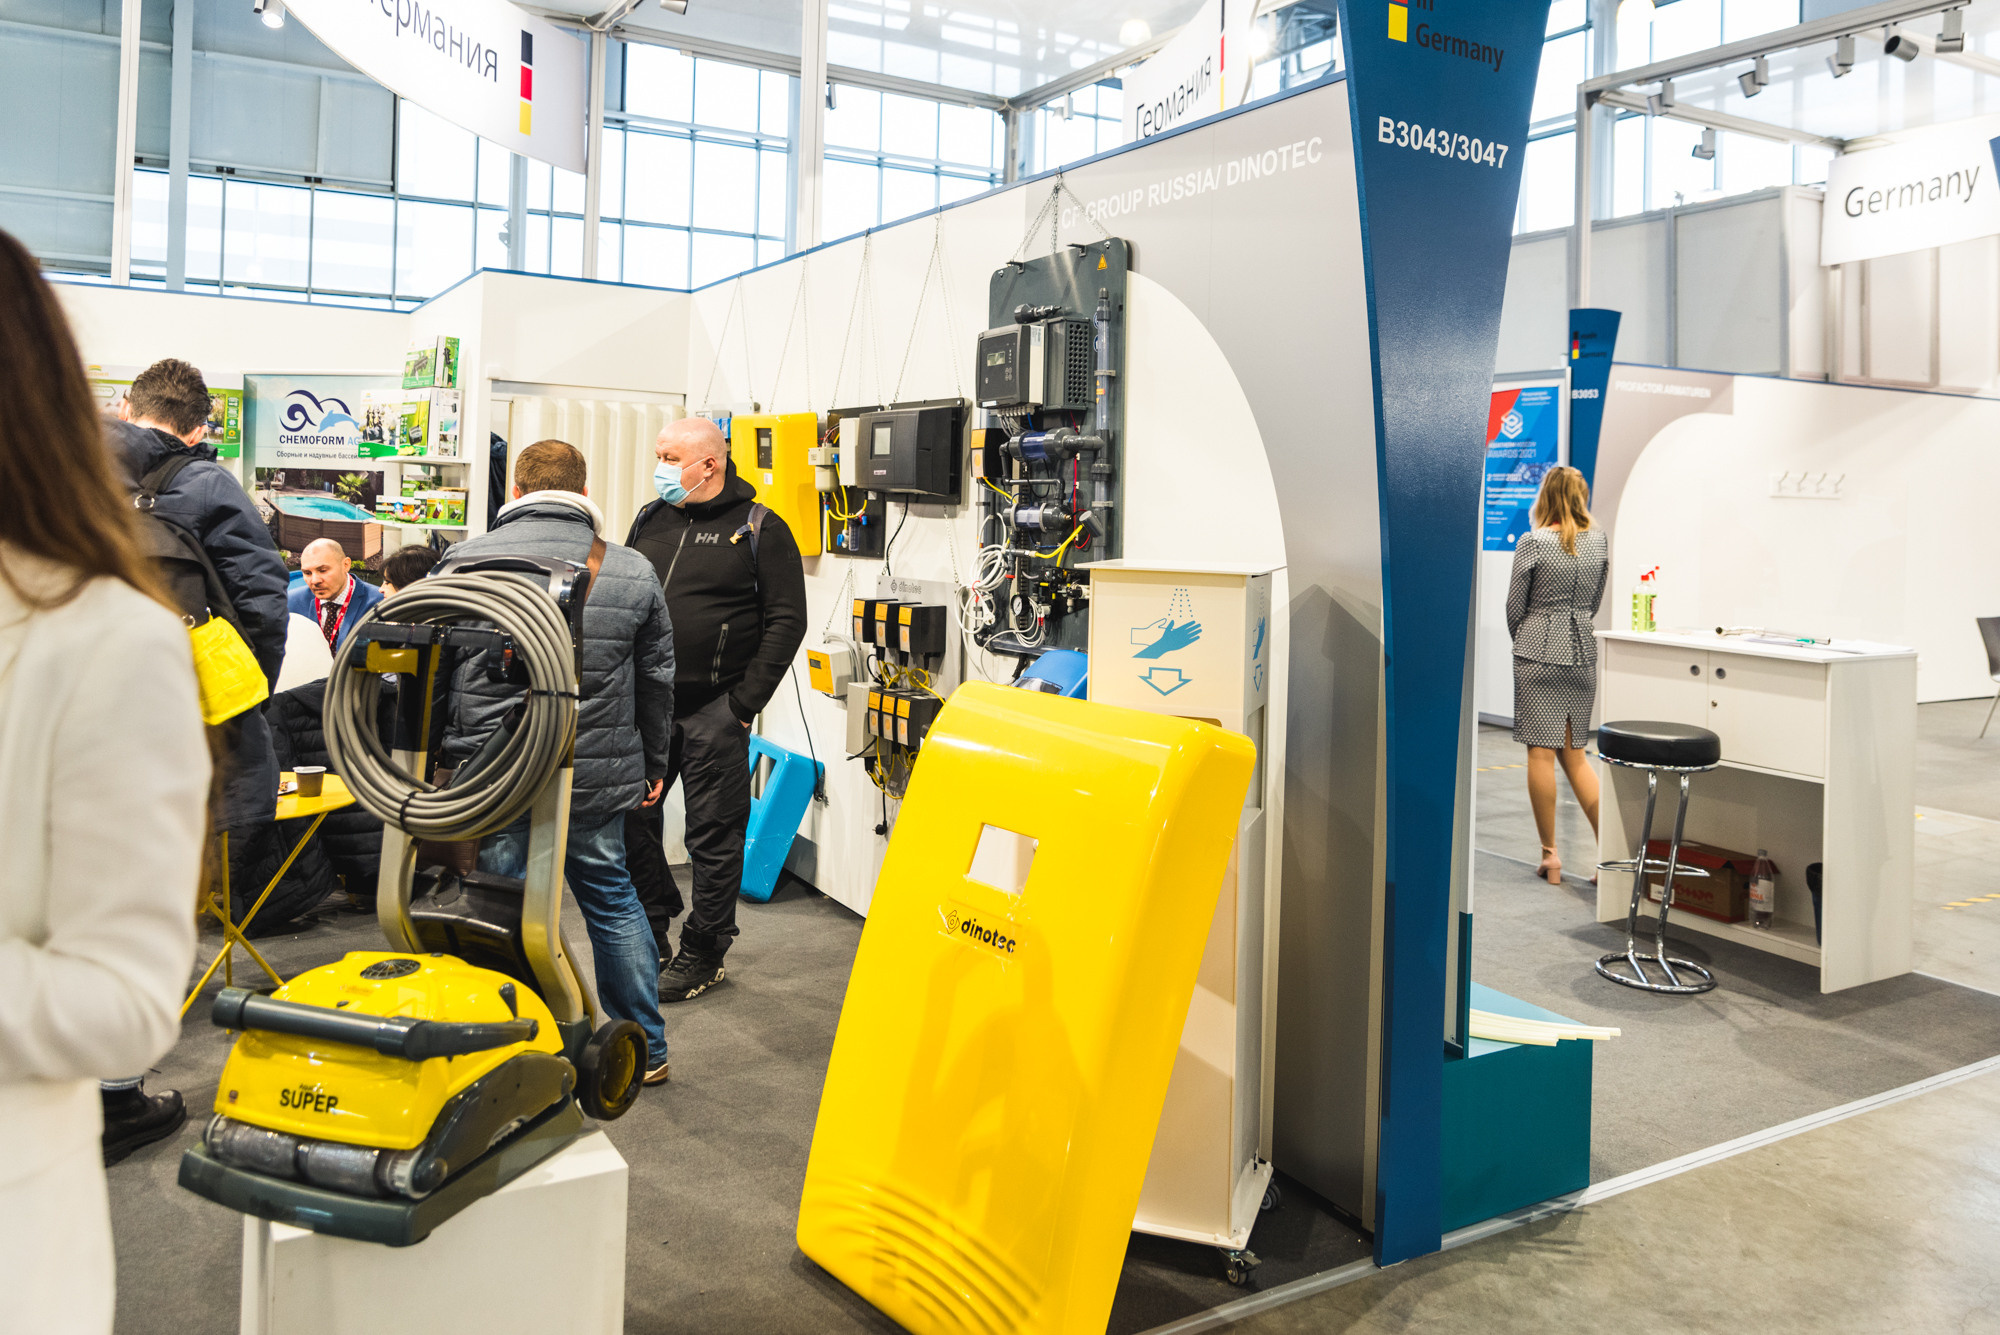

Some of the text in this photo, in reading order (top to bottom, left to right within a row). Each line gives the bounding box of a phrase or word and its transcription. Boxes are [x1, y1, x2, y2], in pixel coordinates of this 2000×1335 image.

[1415, 23, 1504, 73] Germany
[1135, 55, 1212, 141] Германия
[1378, 115, 1509, 169] B3043/3047
[1085, 188, 1144, 222] GROUP
[1148, 164, 1222, 208] RUSSIA/
[1226, 136, 1323, 186] DINOTEC
[1845, 166, 1981, 218] Germany
[1571, 388, 1599, 399] B3053
[1614, 380, 1663, 394] PROFACTOR
[276, 450, 303, 459] Сборные
[279, 434, 345, 445] CHEMOFORM
[695, 532, 720, 544] HH
[961, 918, 1016, 953] dinotec
[279, 1088, 339, 1113] SUPER
